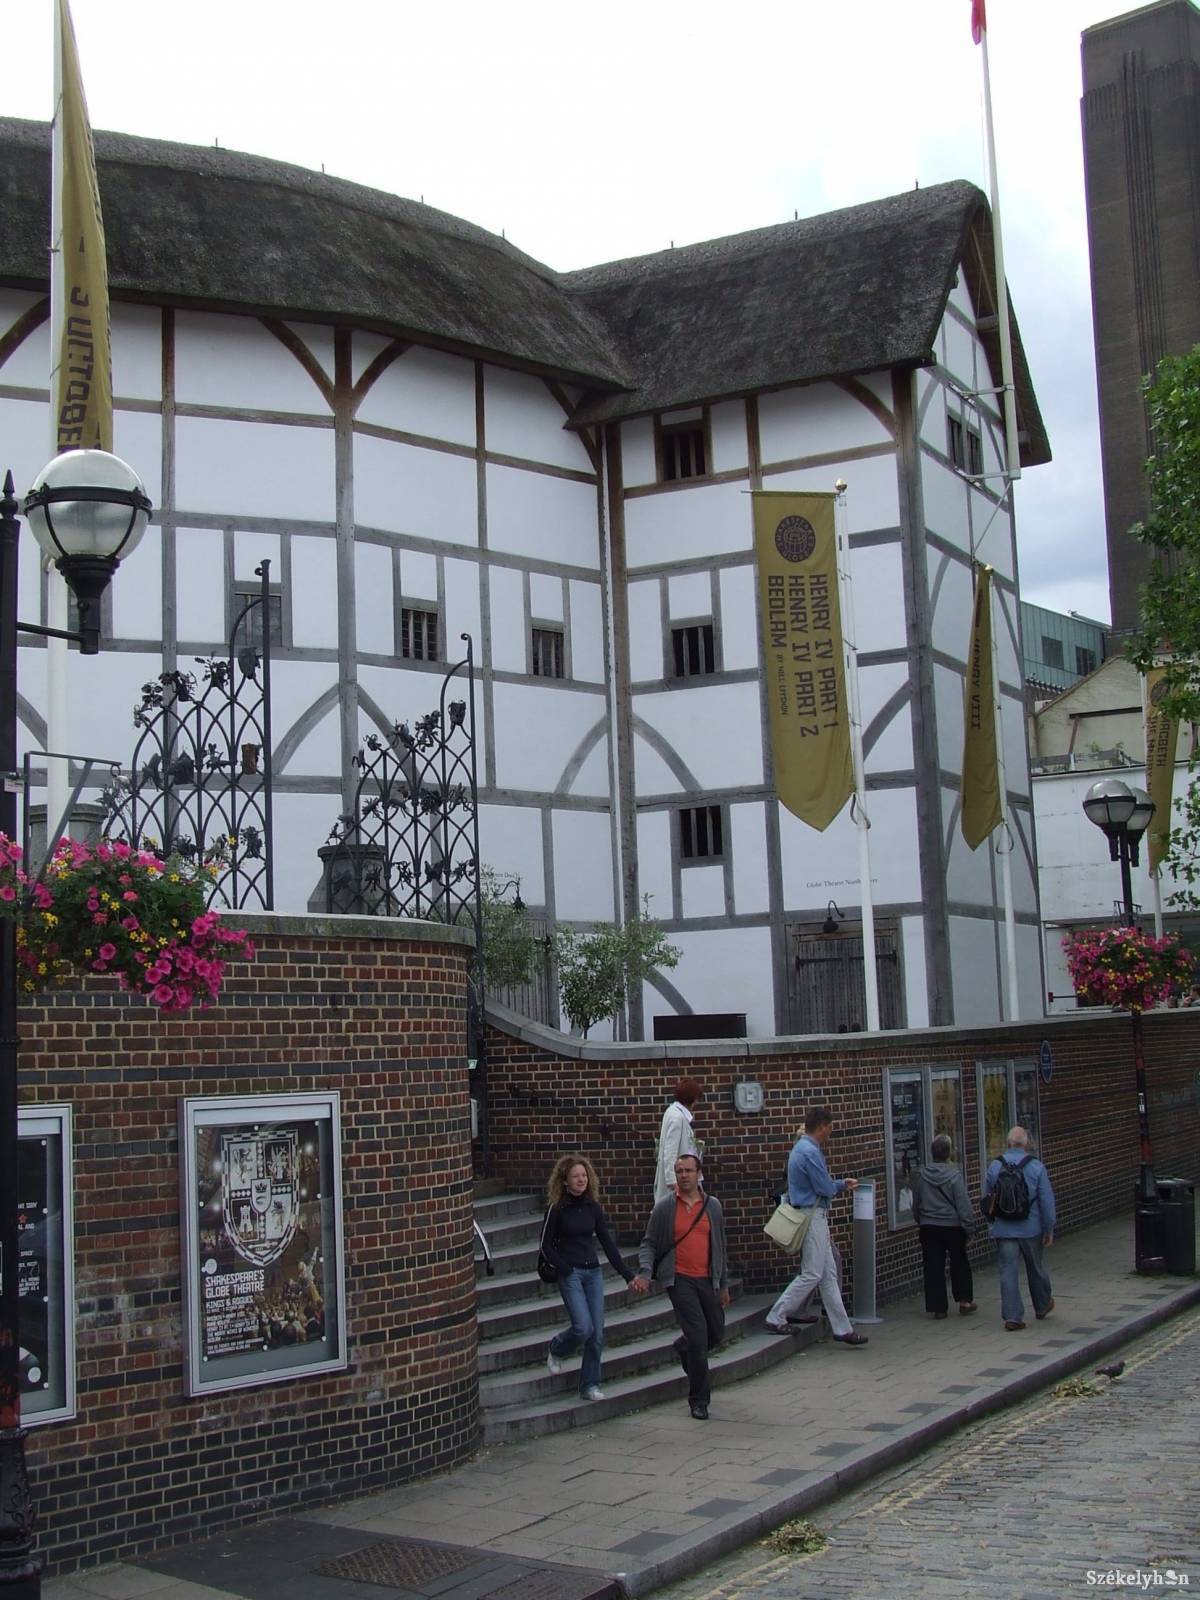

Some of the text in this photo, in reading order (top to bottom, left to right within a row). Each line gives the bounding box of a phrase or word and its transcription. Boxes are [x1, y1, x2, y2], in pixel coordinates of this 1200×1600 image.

[58, 317, 94, 452] OCTOBE
[768, 575, 787, 649] BEDLAM
[788, 575, 819, 738] HENRY IV PART 2
[809, 573, 840, 728] HENRY IV PART 1
[971, 694, 981, 730] VIII
[205, 1269, 265, 1288] SHAKESPEARE'S
[205, 1280, 265, 1299] GLOBE THEATRE
